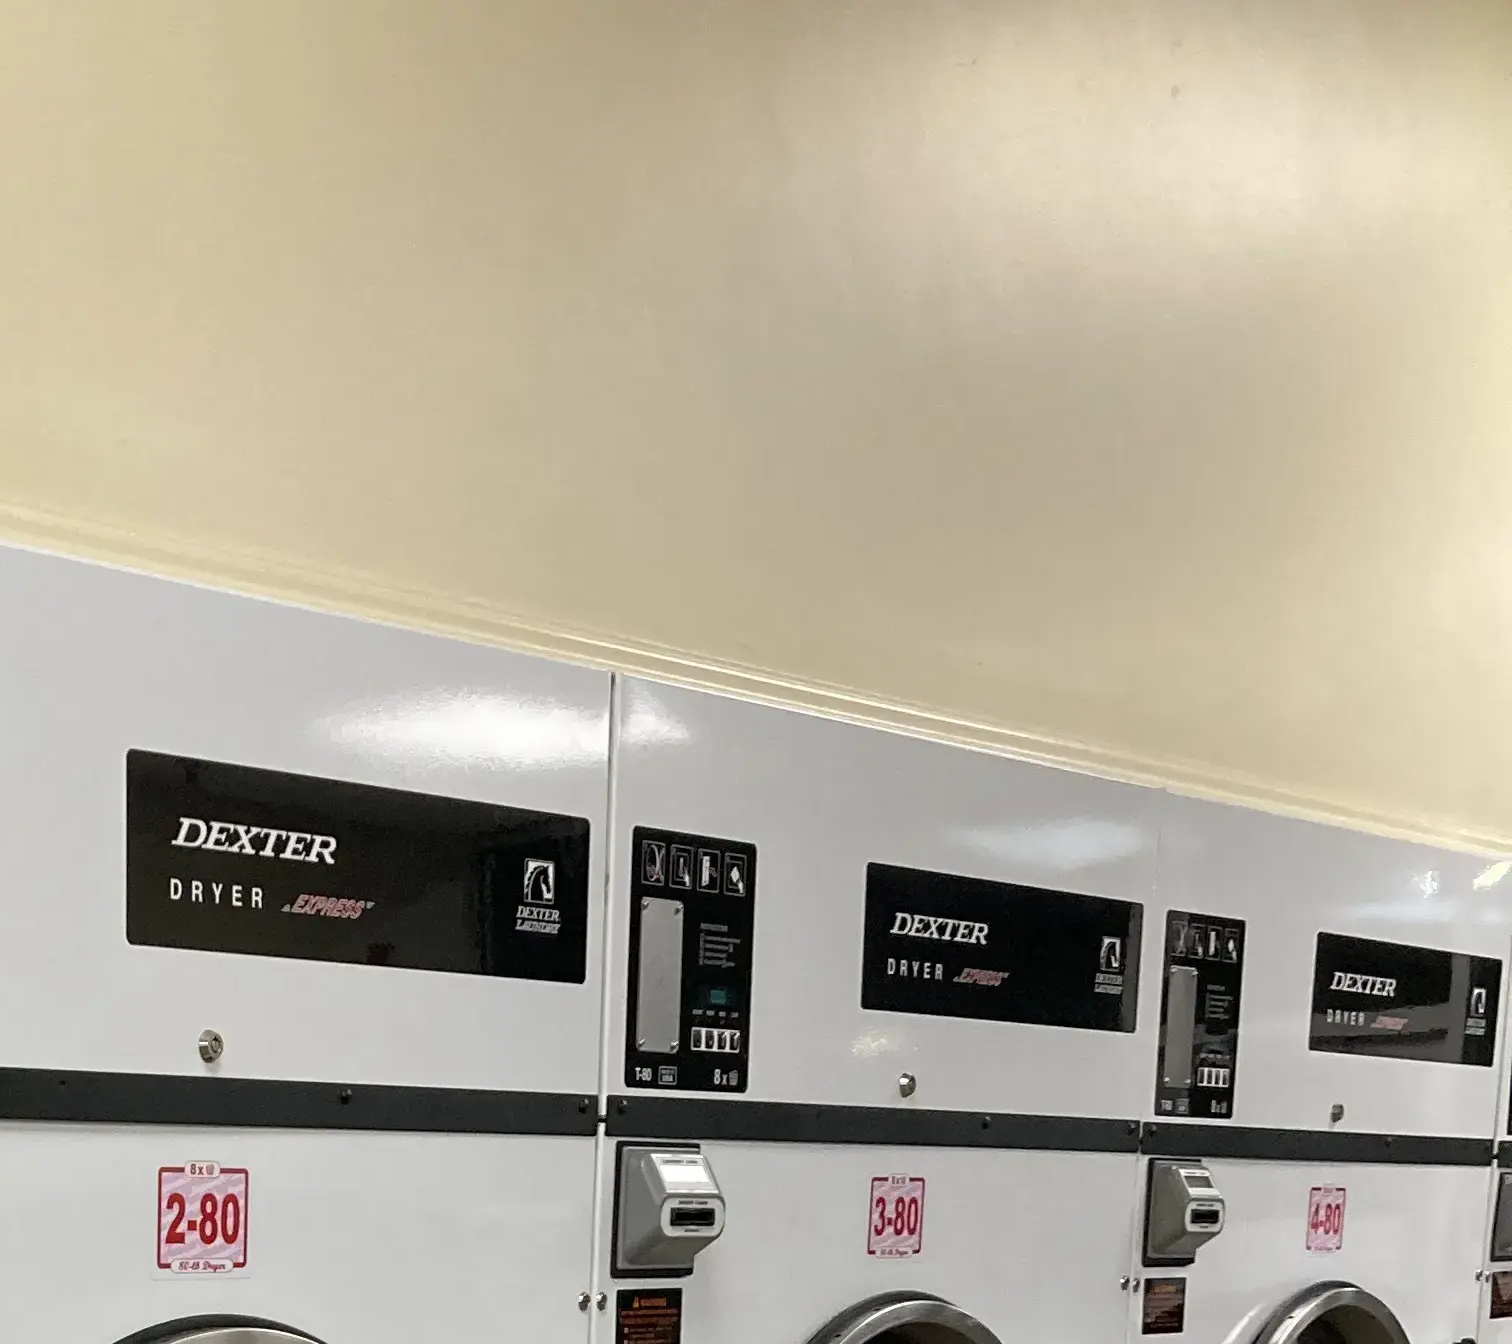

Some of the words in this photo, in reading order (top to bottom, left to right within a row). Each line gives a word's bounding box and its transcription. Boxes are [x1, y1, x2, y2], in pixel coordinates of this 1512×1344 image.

[171, 817, 338, 864] DEXTER
[170, 878, 263, 909] DRYER
[291, 894, 366, 920] EXPRESS
[516, 905, 561, 923] DEXTER
[890, 912, 989, 945] DEXTER
[888, 958, 944, 980] DRYER
[1330, 972, 1396, 997] DEXTER
[165, 1192, 240, 1245] 2-80
[874, 1196, 918, 1236] 3-80
[1311, 1203, 1341, 1235] 4-80
